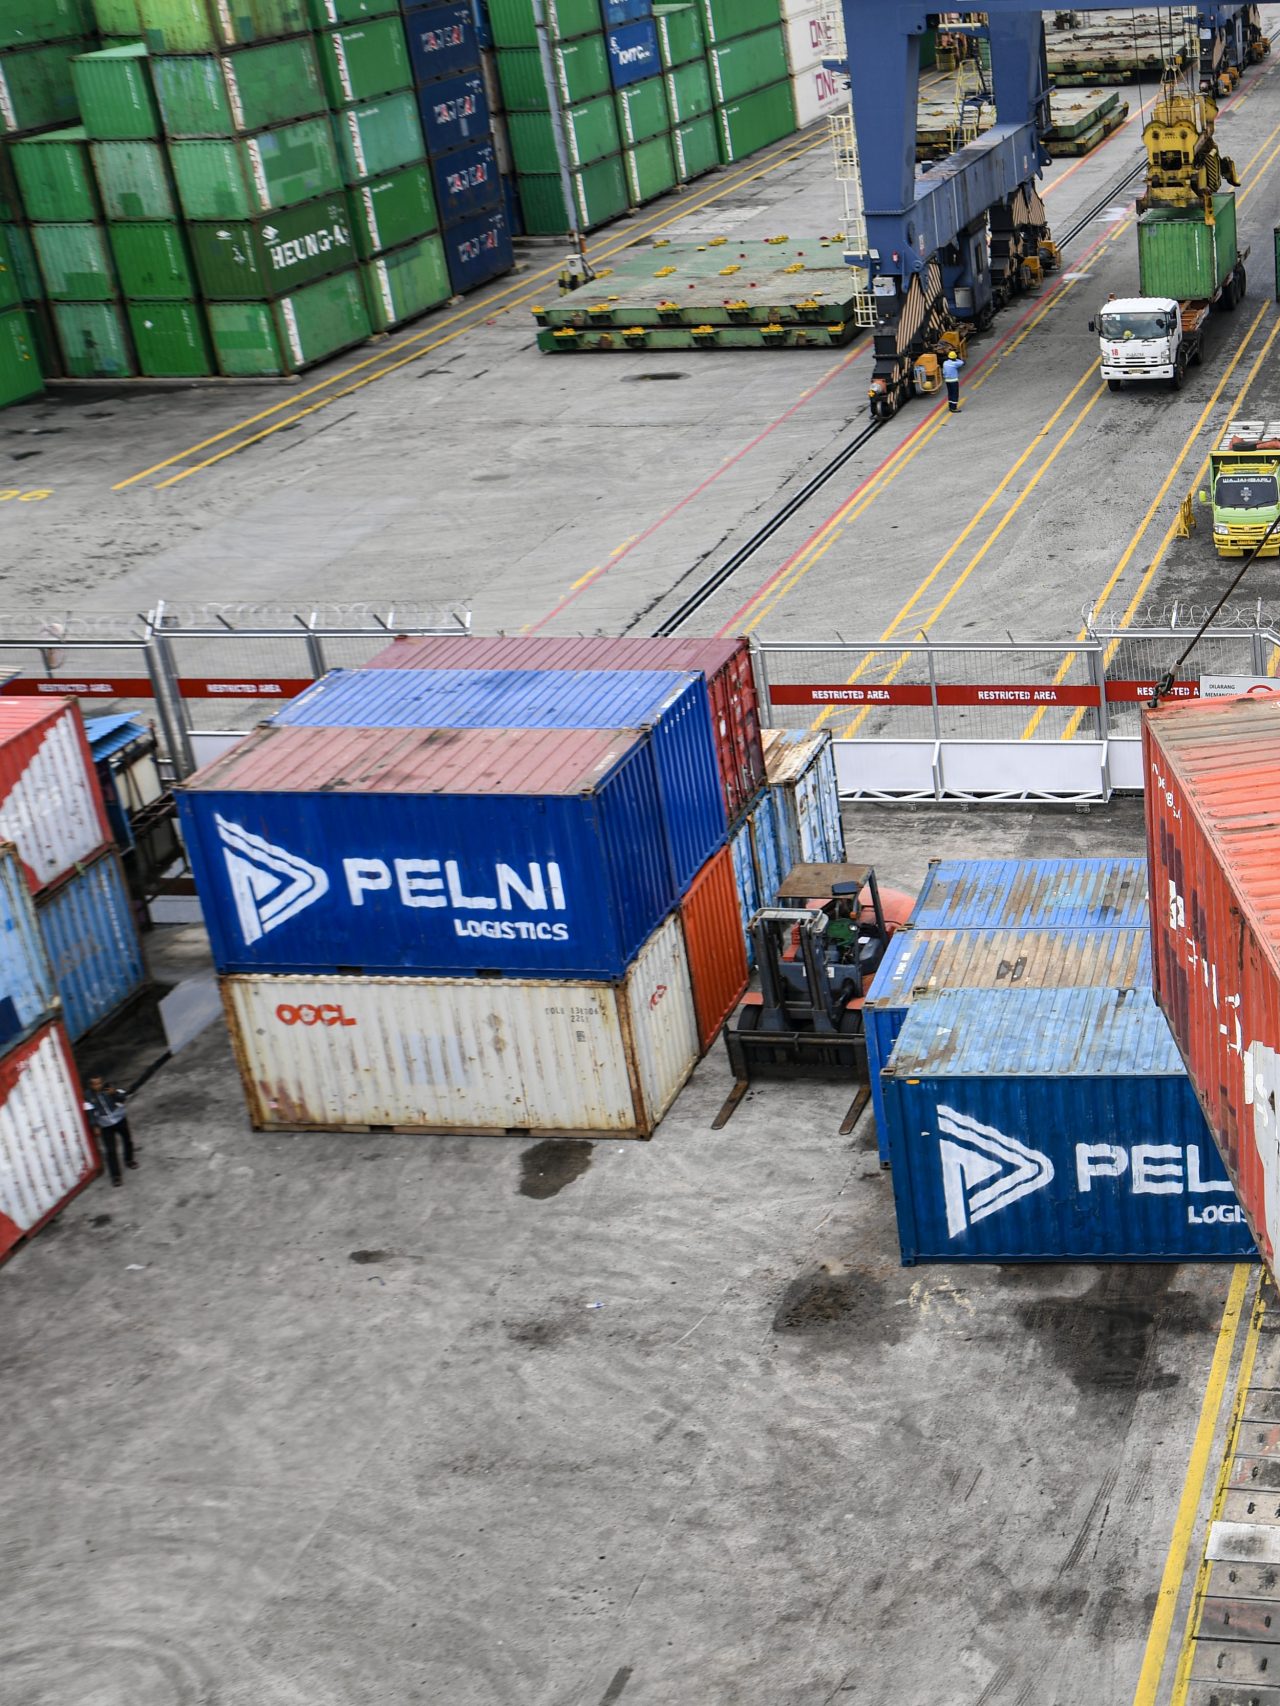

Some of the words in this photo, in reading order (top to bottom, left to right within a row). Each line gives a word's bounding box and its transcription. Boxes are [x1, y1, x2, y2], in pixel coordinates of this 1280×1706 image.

[37, 683, 88, 693] RESTRICTED
[90, 683, 114, 693] AREA
[207, 684, 257, 693] RESTRICTED
[259, 684, 282, 693] AREA
[811, 690, 864, 700] RESTRICTED
[867, 690, 890, 700] AREA
[978, 691, 1031, 700] RESTRICTED
[1033, 691, 1057, 700] AREA
[342, 858, 567, 910] PELNI
[454, 919, 569, 940] LOGISTICS
[276, 1004, 357, 1026] OOCL
[1075, 1143, 1235, 1194] PEL
